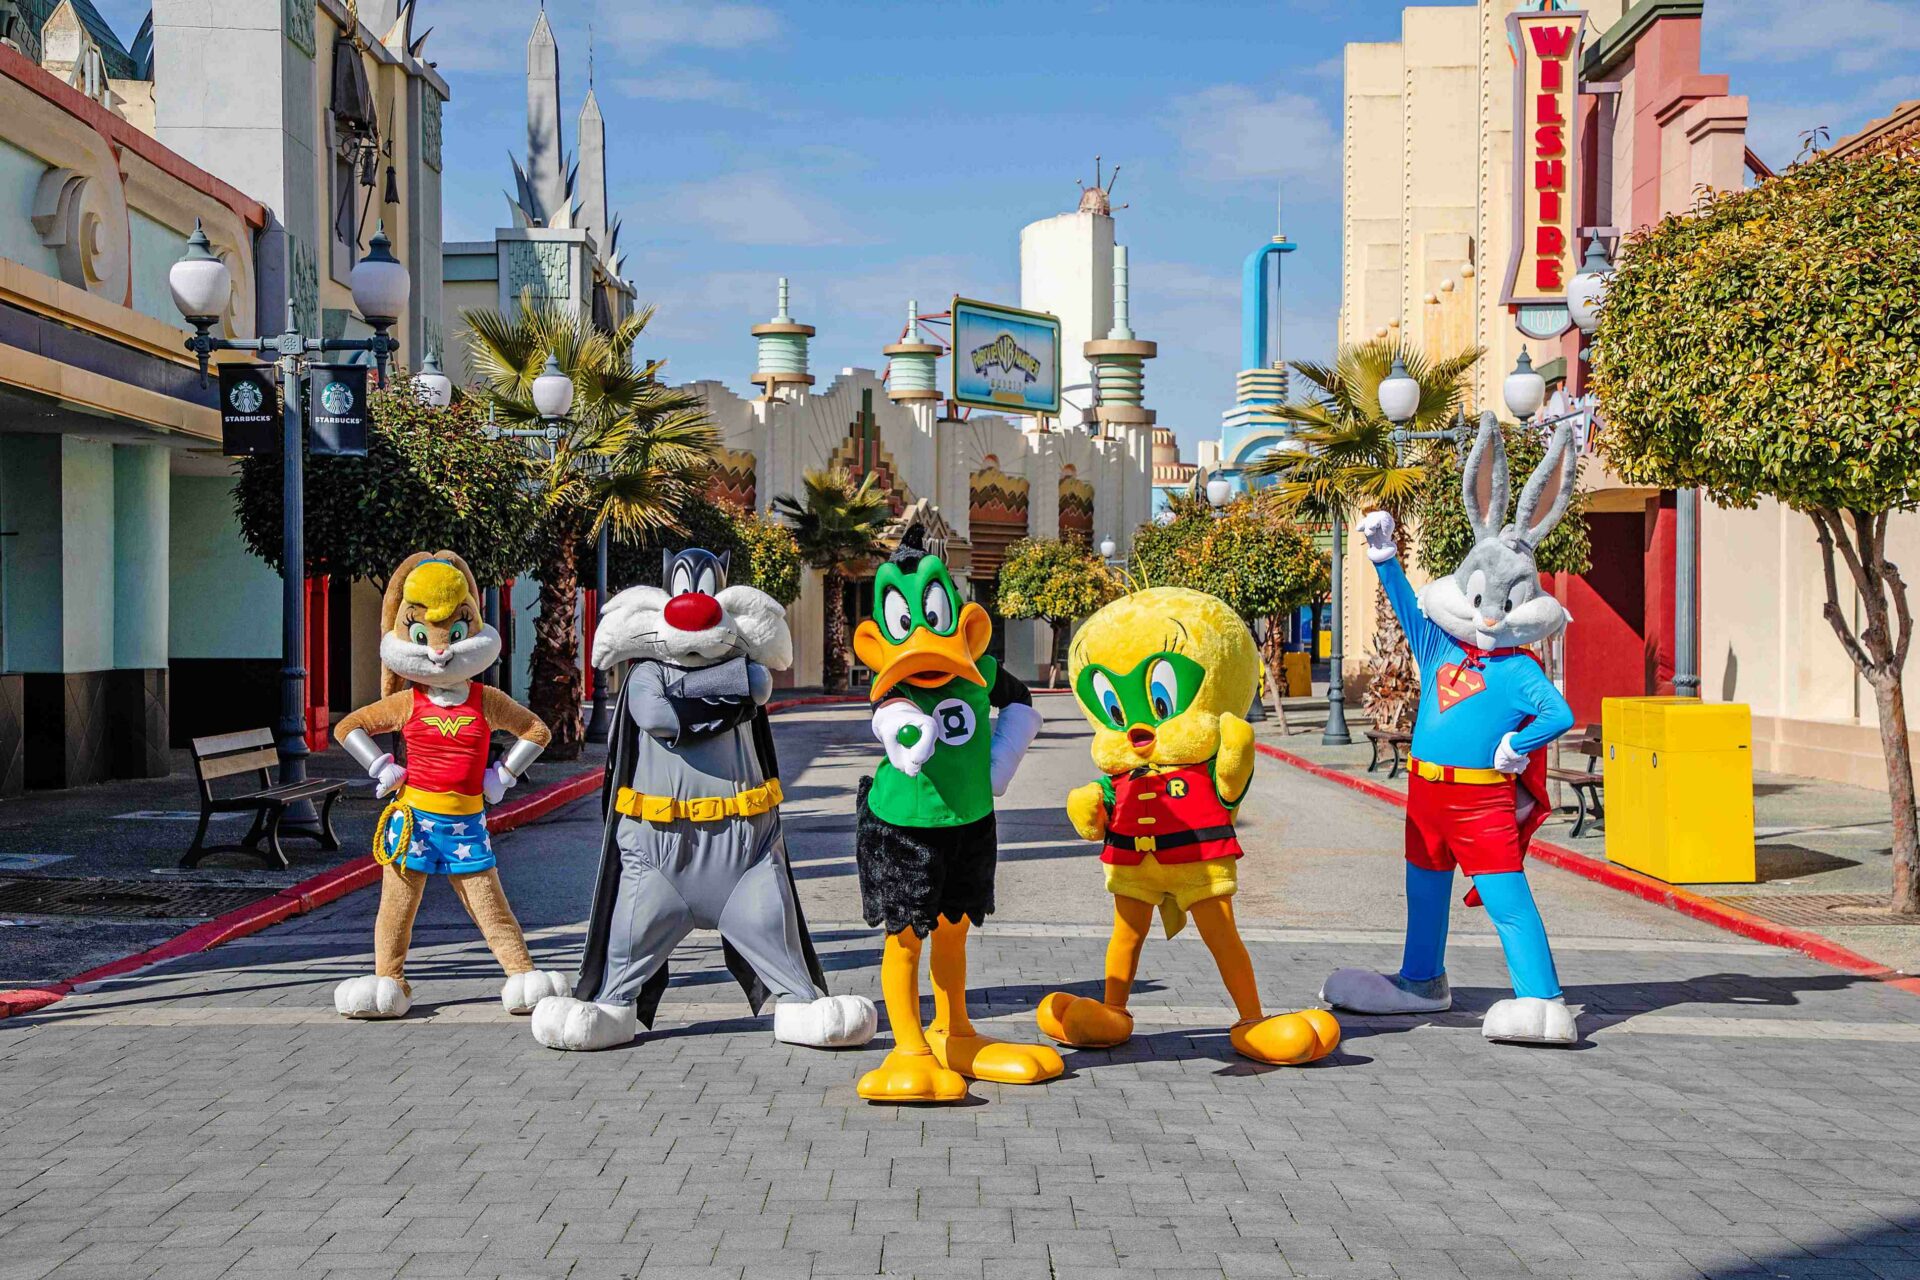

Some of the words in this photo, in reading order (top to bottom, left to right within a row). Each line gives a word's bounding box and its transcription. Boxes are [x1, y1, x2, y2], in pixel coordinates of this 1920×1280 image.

[1529, 26, 1573, 288] WILSHIRE
[1529, 309, 1562, 331] TOYS
[998, 336, 1015, 372] WB
[315, 416, 360, 424] STARBUCKS
[1170, 779, 1185, 797] R
